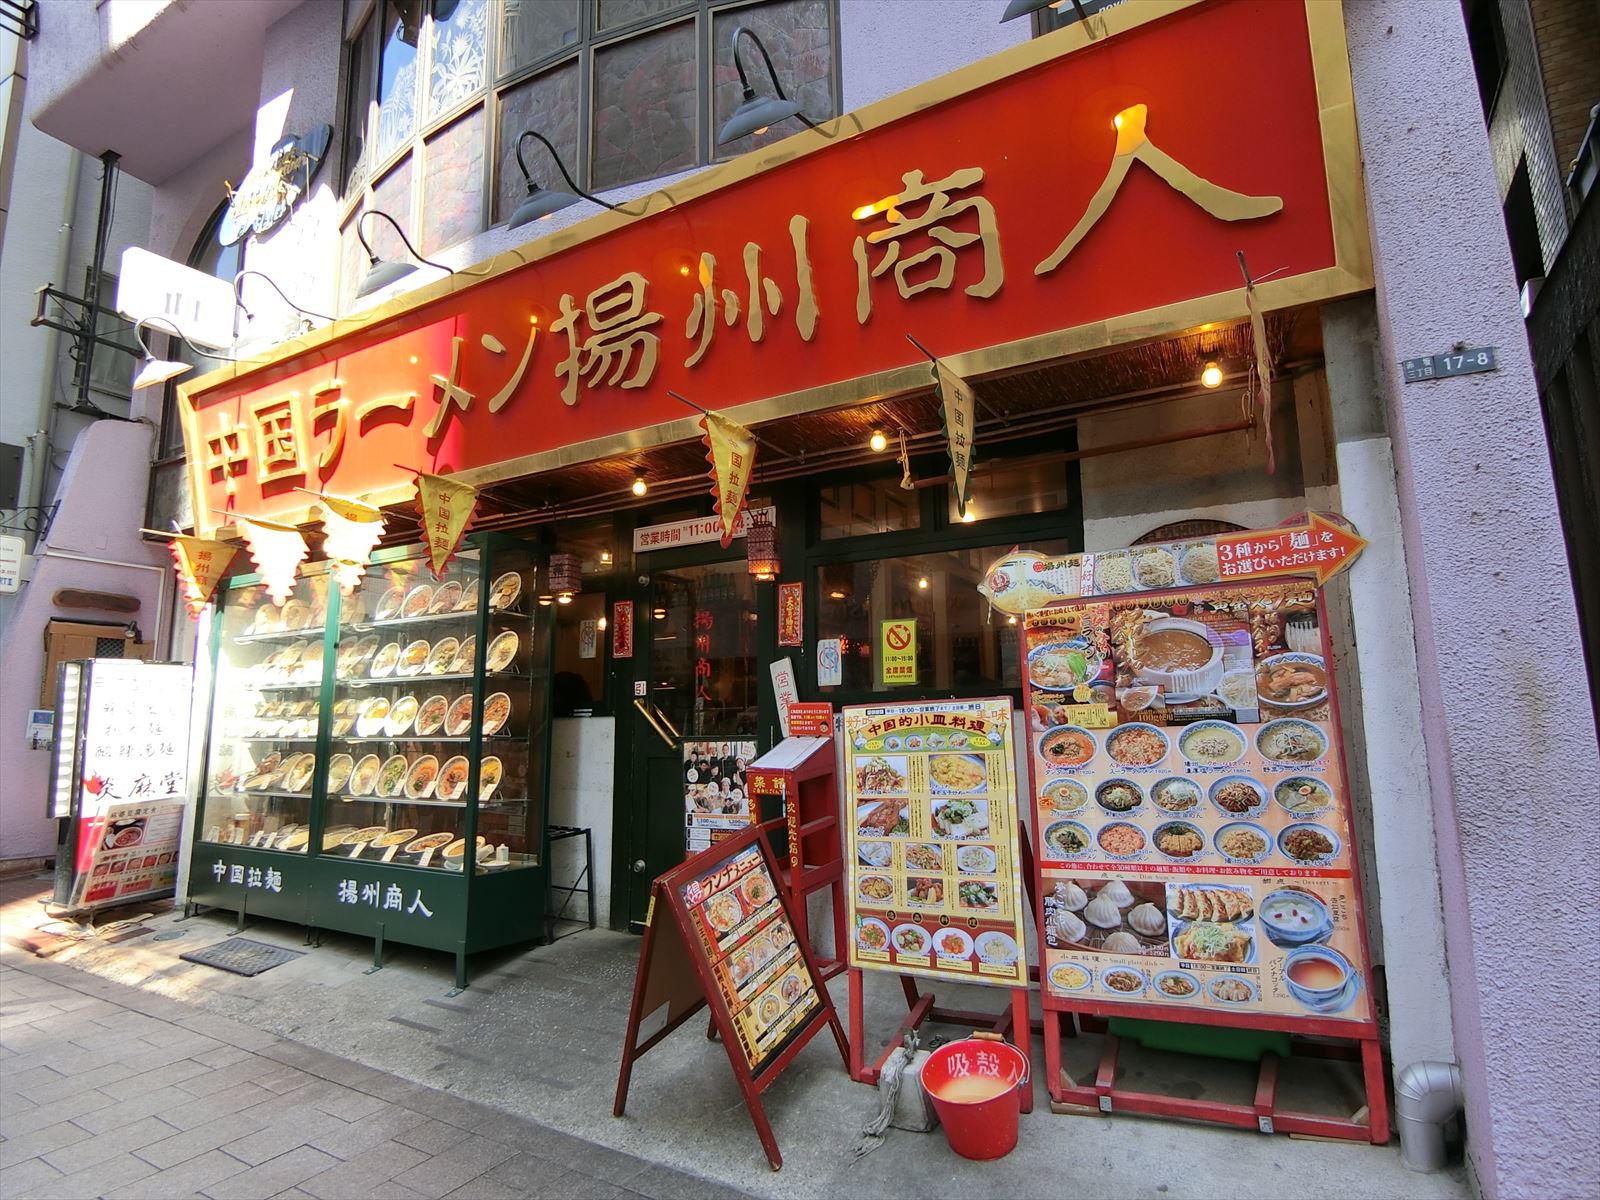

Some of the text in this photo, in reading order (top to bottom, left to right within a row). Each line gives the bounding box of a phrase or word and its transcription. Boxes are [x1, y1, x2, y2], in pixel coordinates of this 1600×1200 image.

[1408, 367, 1432, 379] 三丁目
[1444, 352, 1488, 370] 17-8
[640, 528, 681, 546] 営業時間
[1219, 531, 1334, 561] 3種から「麺」を
[1081, 555, 1094, 597] 大好評
[1222, 546, 1346, 576] お選びいただけます!
[693, 610, 714, 701] 揚州商人
[635, 682, 645, 694] 引
[868, 713, 986, 736] 中国的小皿料理
[212, 859, 284, 893] 中国拉麺
[702, 856, 760, 895] ランチメニュー
[338, 879, 434, 918] 揚州商人
